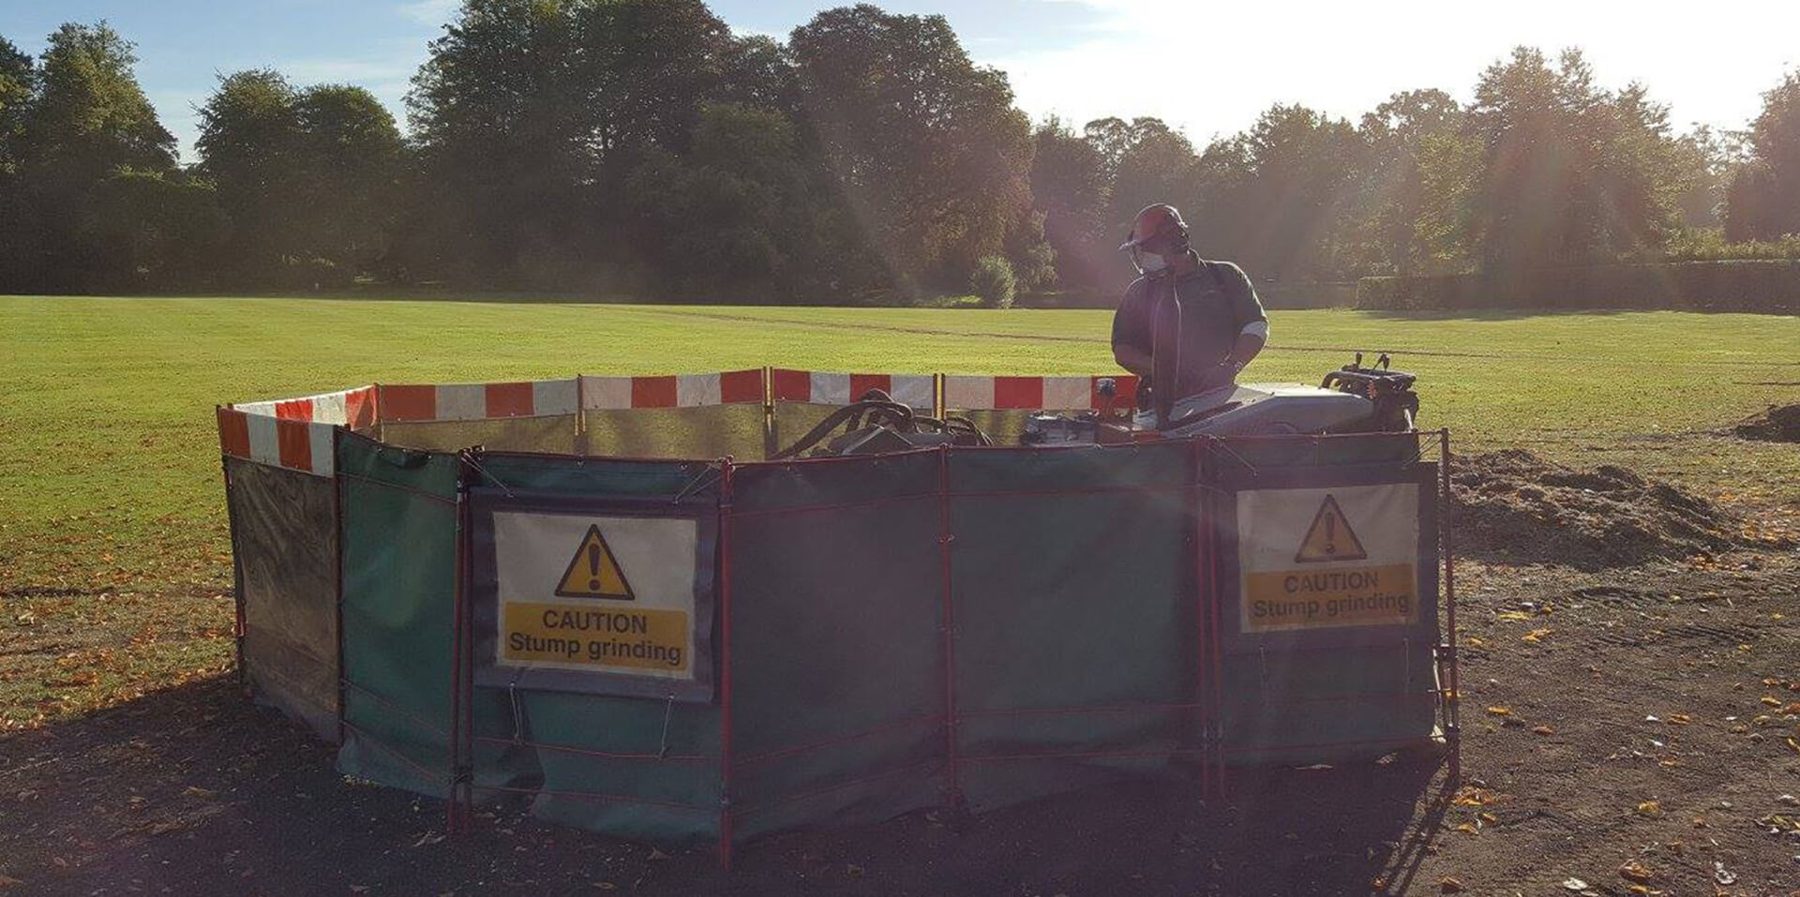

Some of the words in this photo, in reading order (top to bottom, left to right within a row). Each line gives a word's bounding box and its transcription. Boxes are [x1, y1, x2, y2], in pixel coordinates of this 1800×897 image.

[1284, 572, 1378, 593] CAUTION
[1253, 600, 1319, 618] Stump
[1327, 592, 1409, 616] grinding
[543, 610, 647, 633] CAUTION
[510, 632, 581, 658] Stump
[588, 638, 681, 665] grinding
